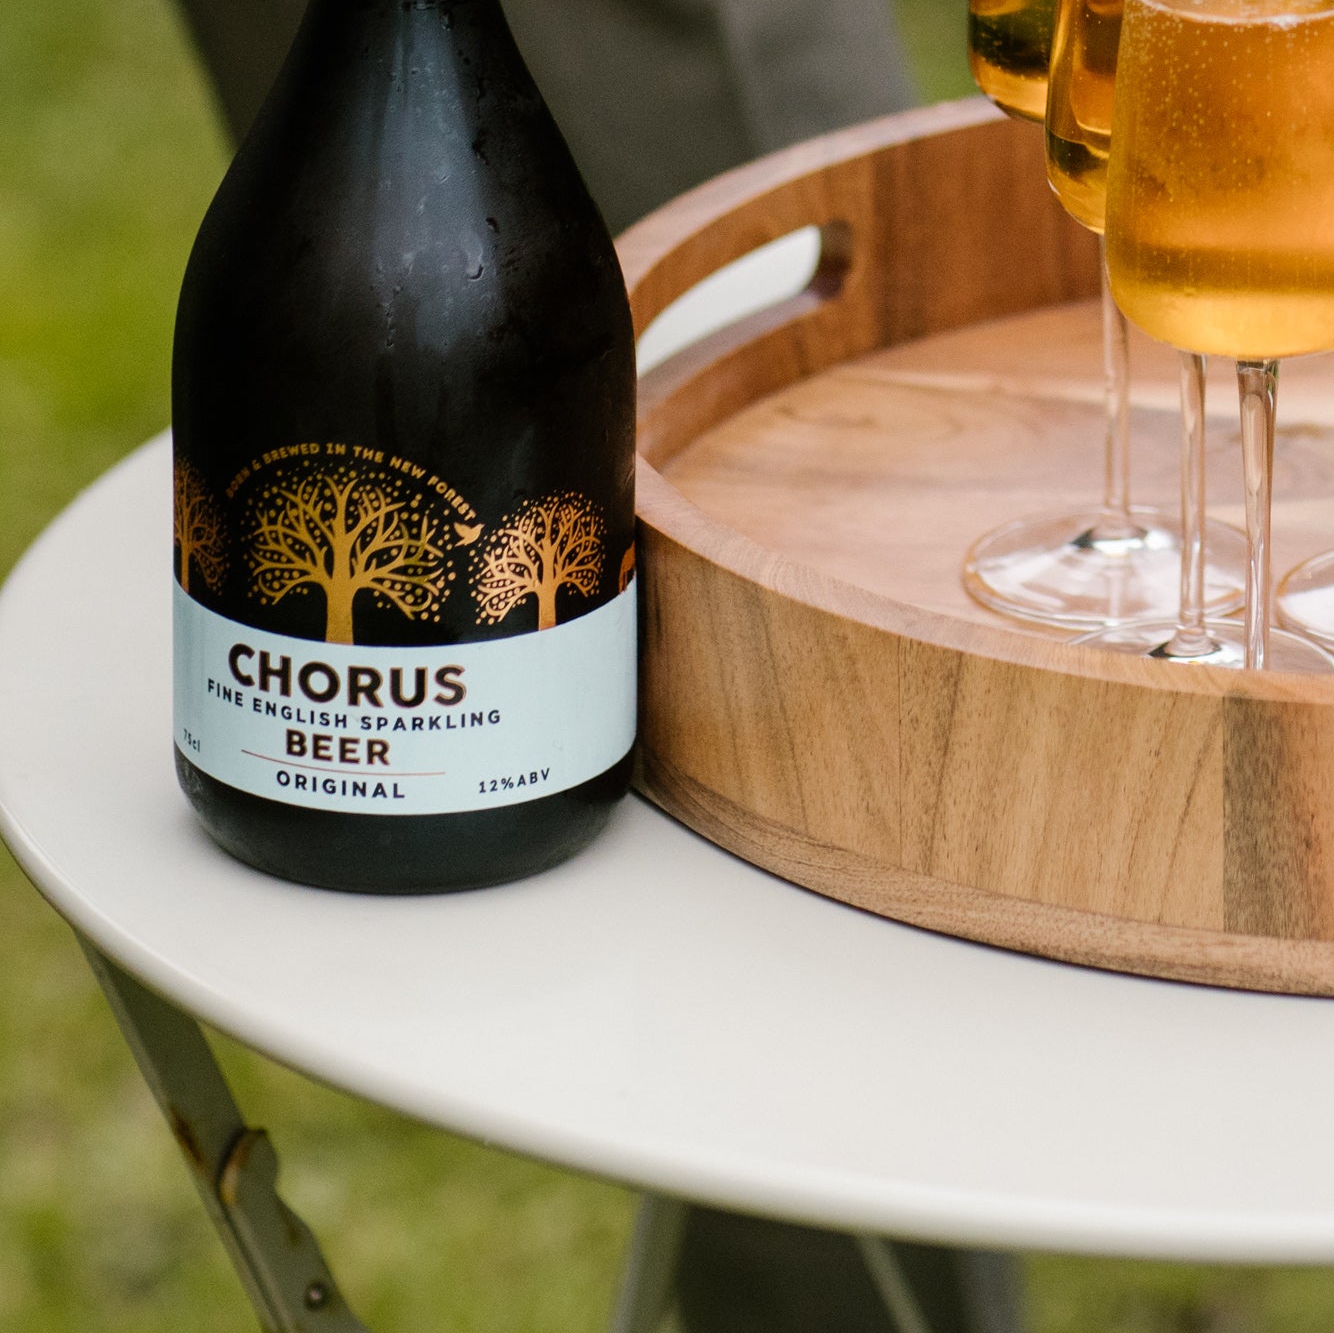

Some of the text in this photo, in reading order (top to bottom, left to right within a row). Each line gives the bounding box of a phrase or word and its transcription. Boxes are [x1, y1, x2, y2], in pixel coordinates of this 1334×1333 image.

[262, 442, 320, 465] BREWED
[326, 442, 347, 455] IN
[353, 445, 385, 463] THE
[389, 455, 427, 479] NEW
[427, 475, 477, 521] FOREST
[228, 642, 467, 709] CHORUS
[207, 678, 501, 732] FINE ENGLISH SPARKLING
[183, 727, 201, 753] 75cl
[285, 727, 391, 766] BEER
[276, 769, 406, 799] ORIGINAL
